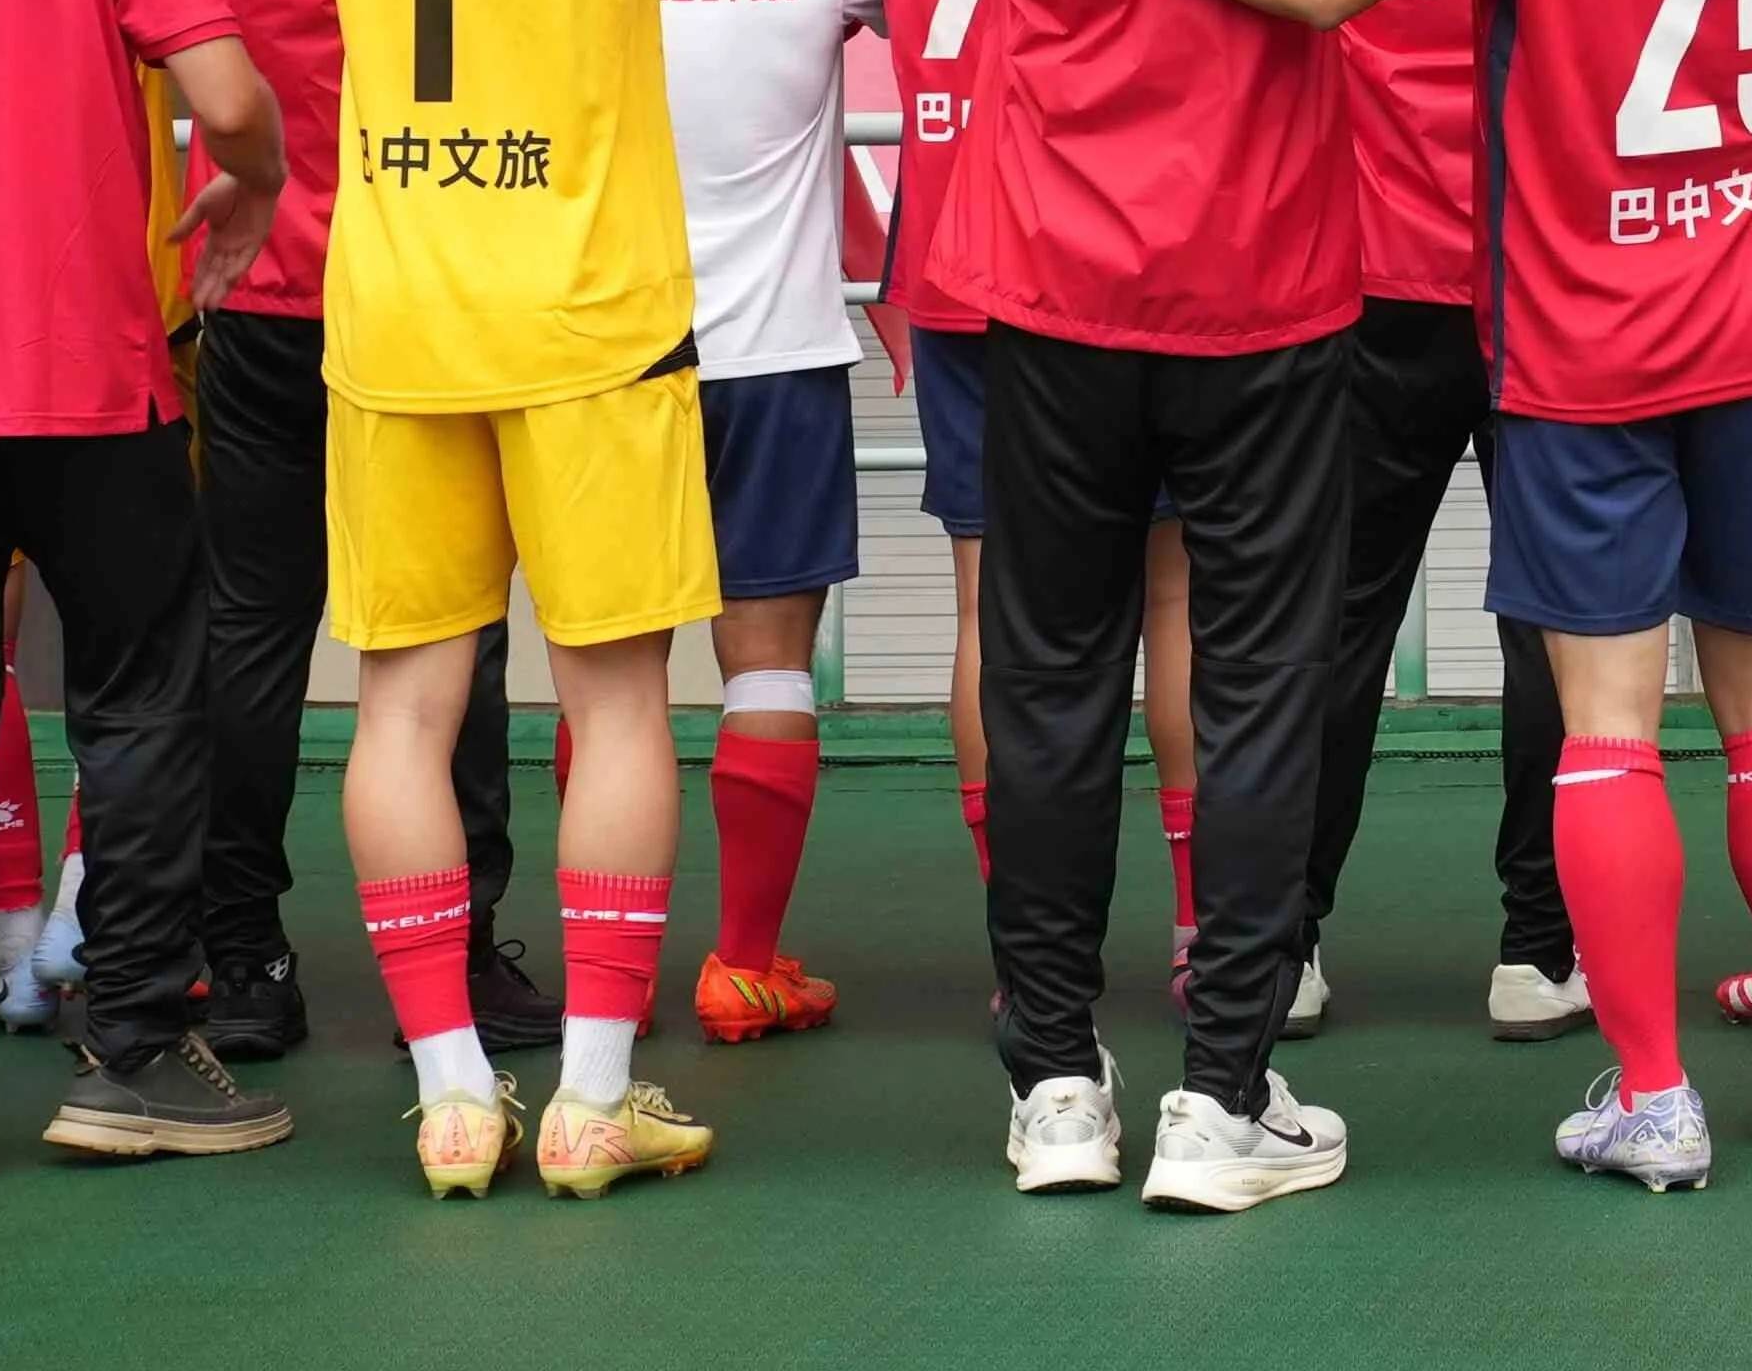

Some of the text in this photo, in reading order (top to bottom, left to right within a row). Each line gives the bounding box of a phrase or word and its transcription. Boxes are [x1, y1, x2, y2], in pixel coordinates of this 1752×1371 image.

[359, 125, 551, 191] 中文旅
[380, 904, 465, 931] KELME
[560, 906, 621, 921] ELME
